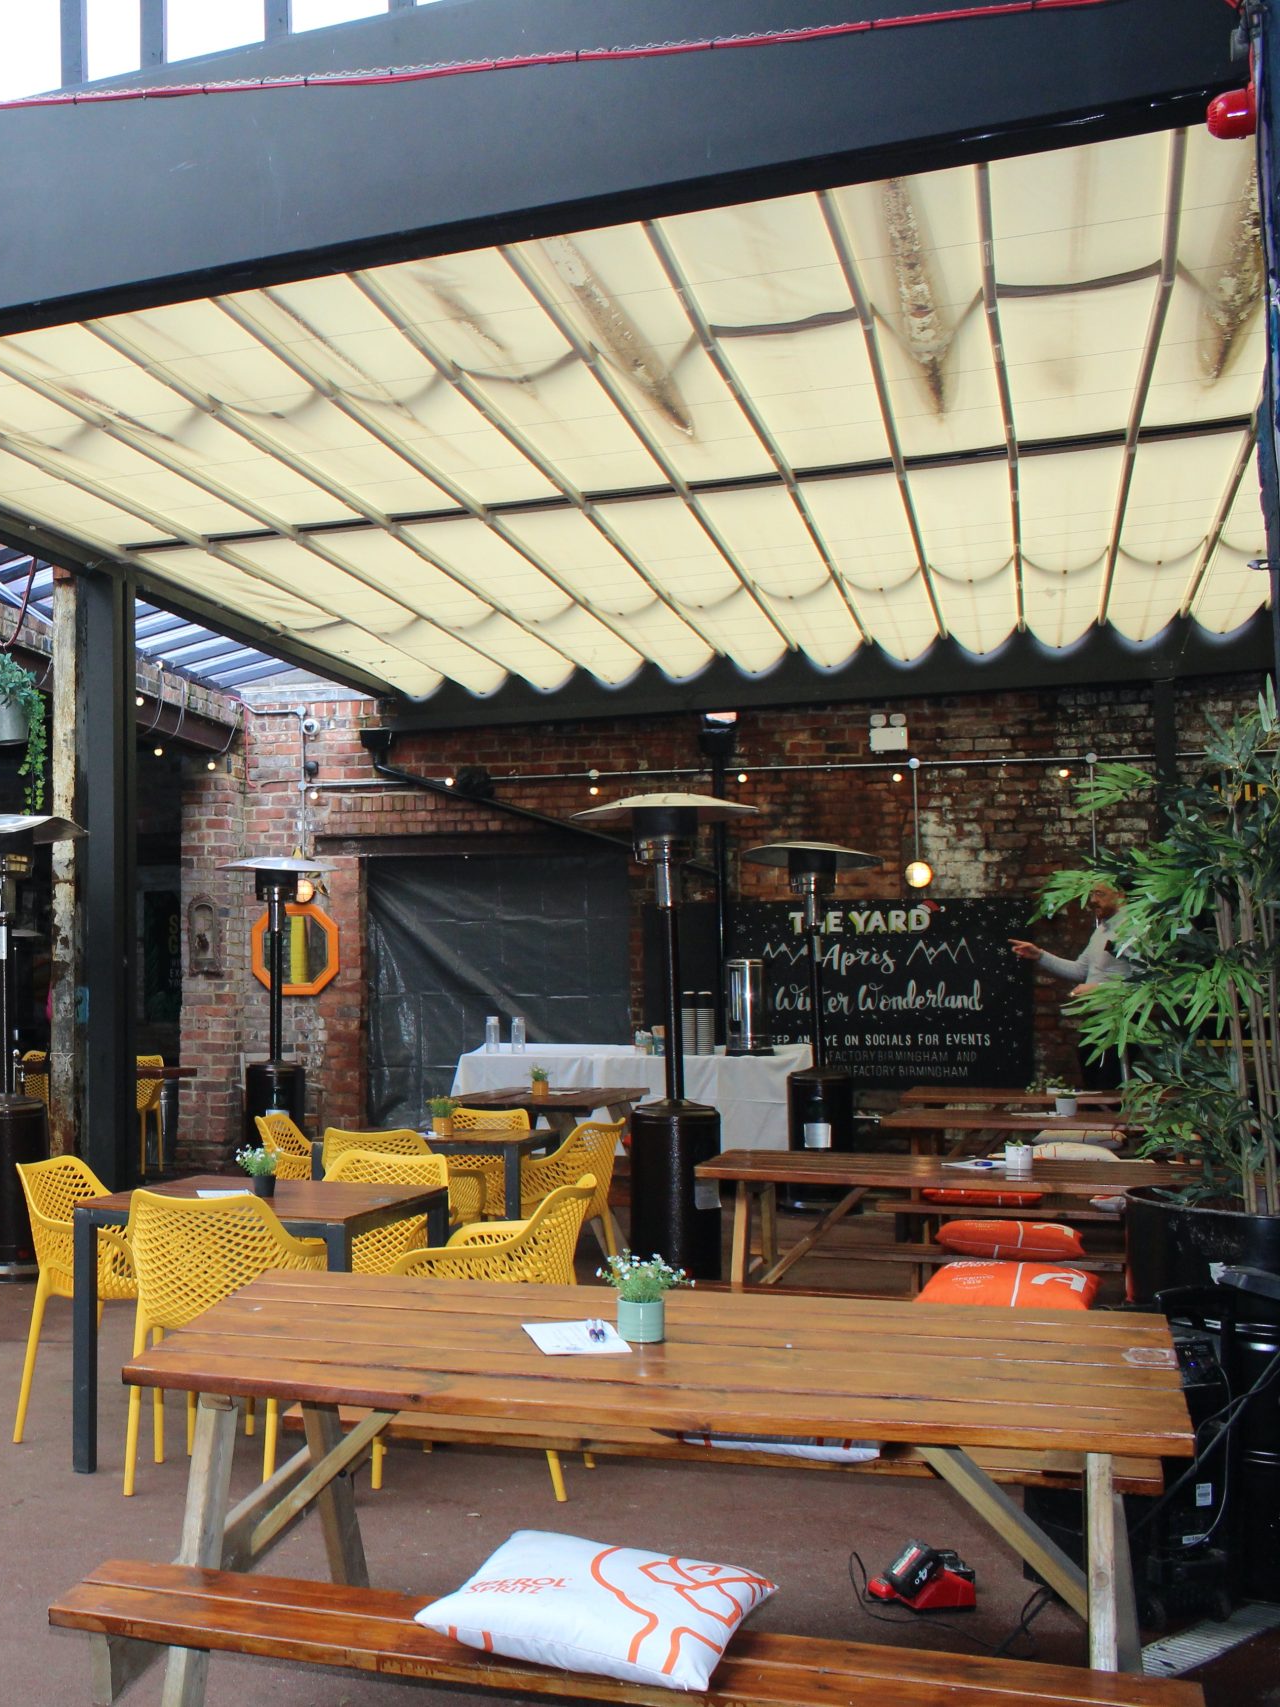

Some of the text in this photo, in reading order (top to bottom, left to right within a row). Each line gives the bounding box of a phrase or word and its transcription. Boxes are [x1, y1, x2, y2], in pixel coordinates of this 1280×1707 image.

[848, 908, 930, 935] YARD
[821, 943, 896, 975] Après
[857, 979, 983, 1011] Wonderland
[823, 1033, 838, 1047] YE
[844, 1033, 859, 1047] ON
[865, 1033, 911, 1047] SOCIALS
[918, 1033, 939, 1047] FOR
[946, 1033, 991, 1047] EVENTS
[956, 1050, 976, 1062] AND
